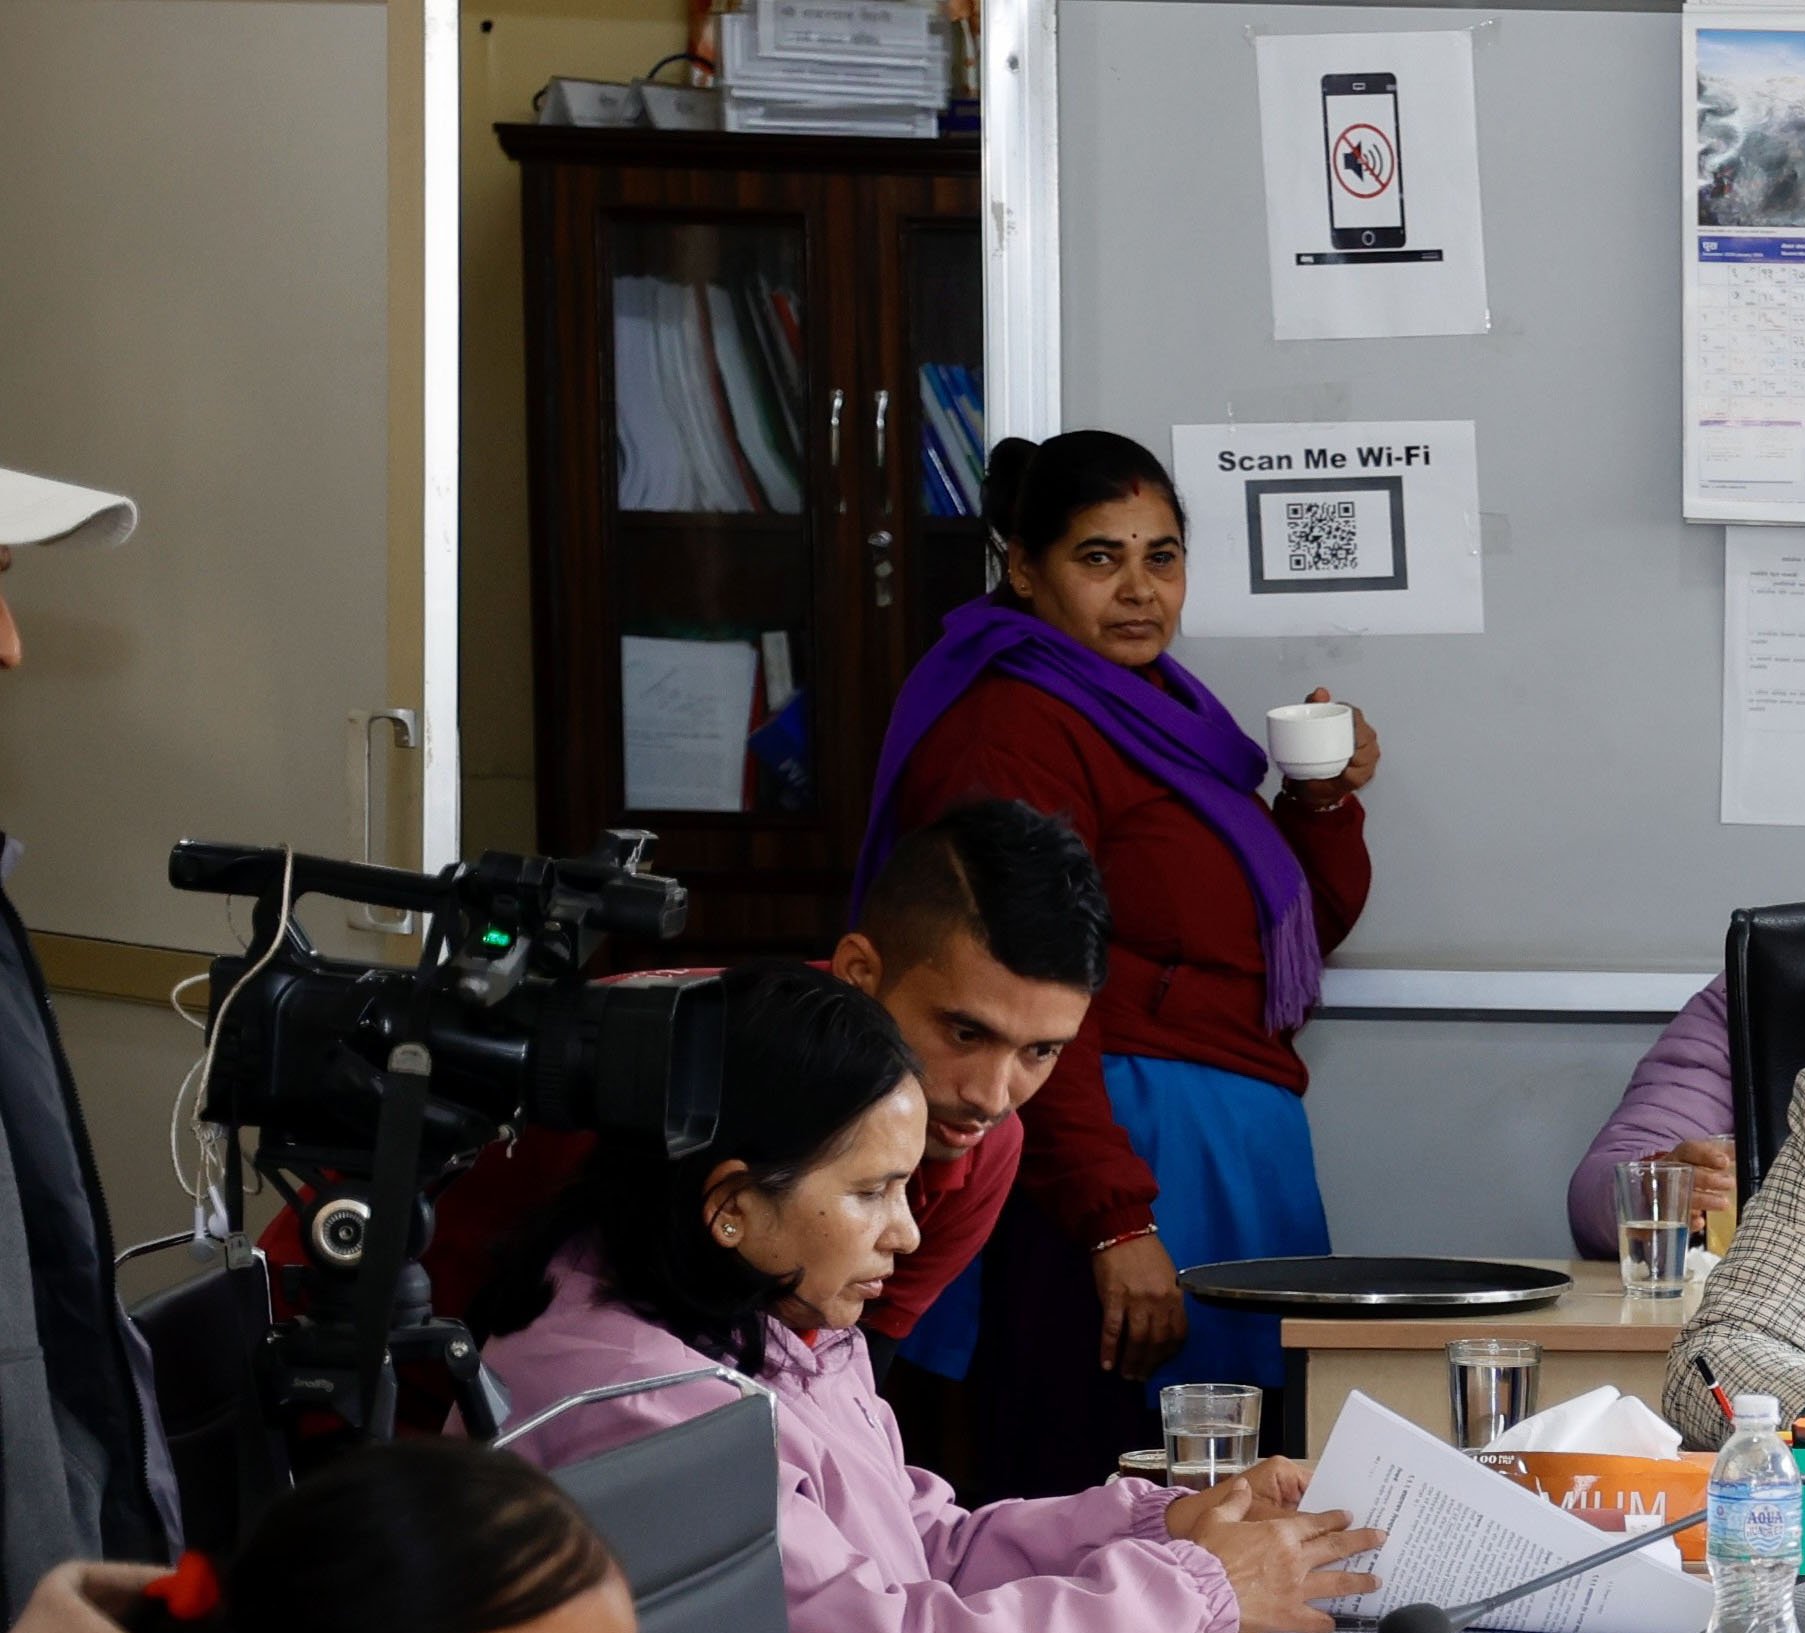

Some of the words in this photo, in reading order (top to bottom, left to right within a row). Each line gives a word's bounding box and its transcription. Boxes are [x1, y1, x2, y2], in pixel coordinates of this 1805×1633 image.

[1219, 451, 1292, 471] Scan
[1305, 449, 1346, 469] Me
[1357, 445, 1429, 467] Wi-Fi
[1747, 1511, 1782, 1524] AQUA
